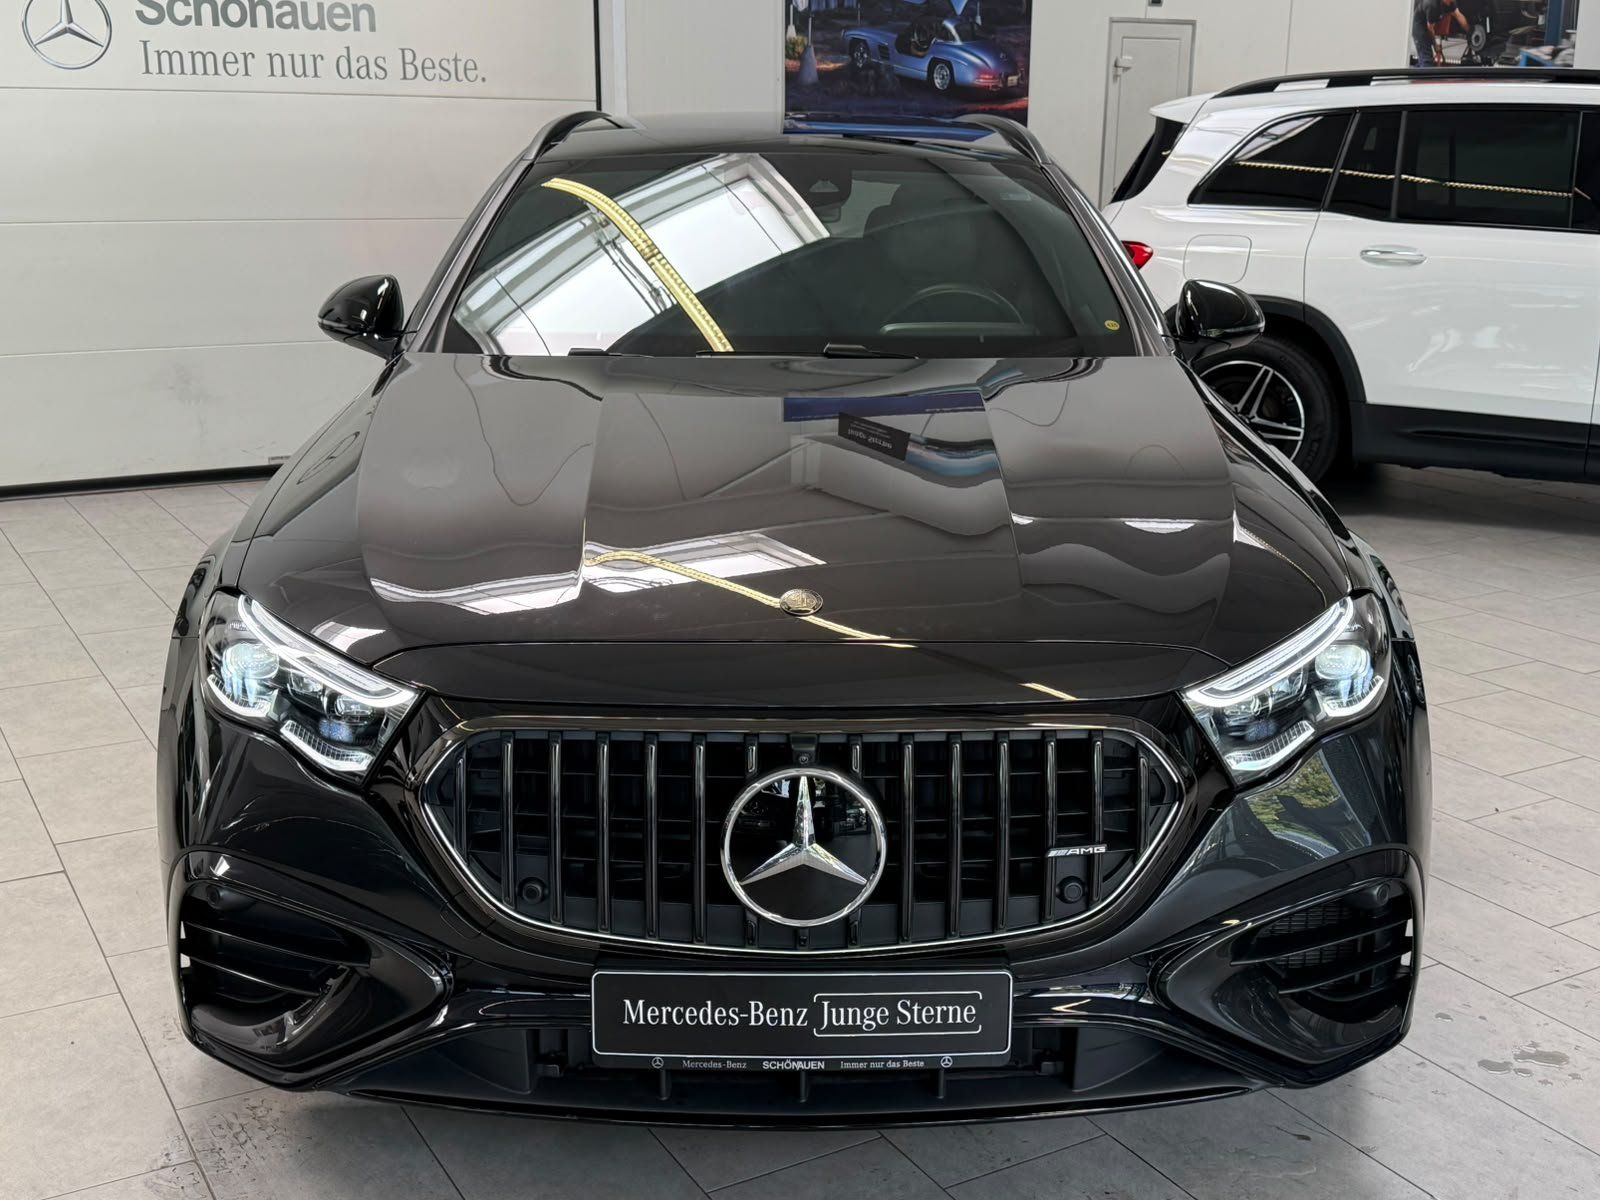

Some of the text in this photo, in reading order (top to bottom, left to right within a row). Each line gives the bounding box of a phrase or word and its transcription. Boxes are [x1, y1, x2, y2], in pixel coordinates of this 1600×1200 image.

[139, 39, 487, 83] Immer nur das Beste.
[1066, 847, 1106, 855] AMG
[623, 999, 977, 1032] Mercedes-Benz Junge Sterne
[682, 1059, 925, 1070] Mercedes-Benz SCHÖNAUEN Immer nur das Beste
